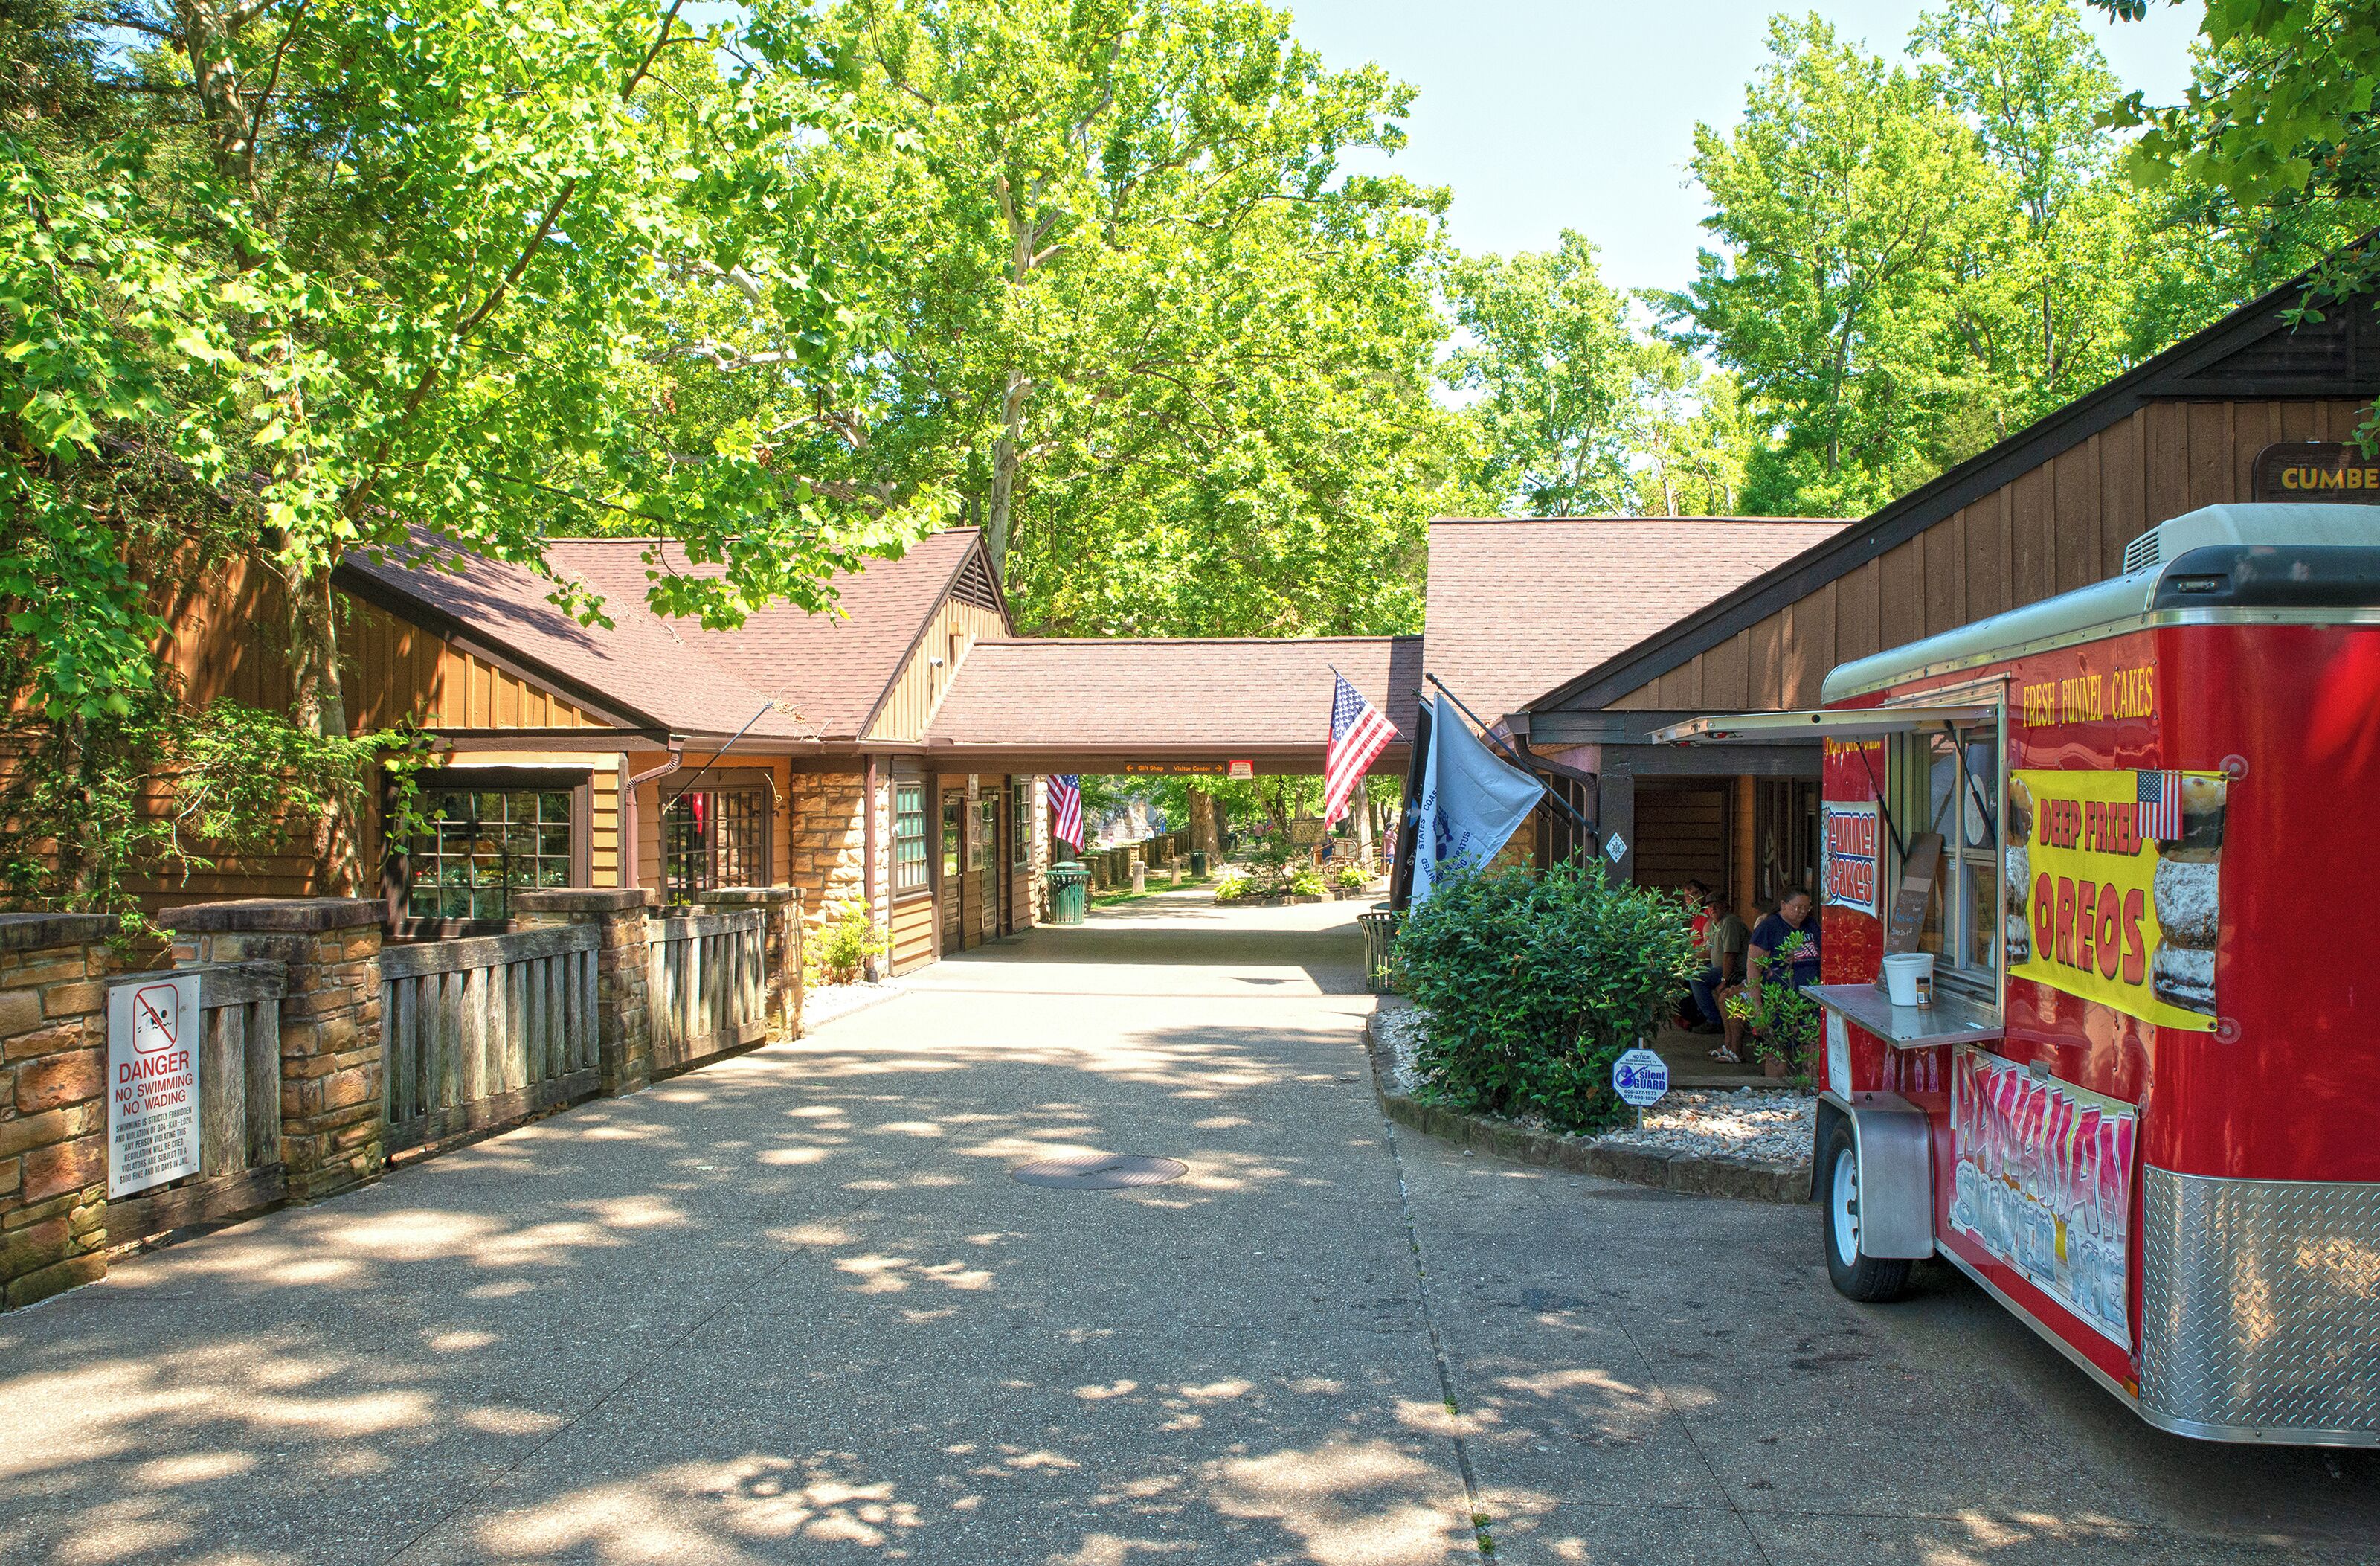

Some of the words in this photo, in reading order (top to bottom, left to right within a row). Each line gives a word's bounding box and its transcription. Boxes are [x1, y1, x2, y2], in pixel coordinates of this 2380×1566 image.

[2281, 467, 2379, 490] CUMBE
[2023, 681, 2056, 728] FRESH
[2062, 674, 2104, 724] FUNNEL
[2112, 665, 2153, 719] CAKES
[1424, 788, 1437, 811] COAS
[2039, 798, 2082, 850] DEEP
[1421, 858, 1437, 883] NITED
[2034, 872, 2145, 986] OREOS
[119, 1050, 190, 1084] DANGER
[1639, 1070, 1665, 1081] silent
[115, 1087, 132, 1103] NO
[137, 1072, 193, 1097] SWIMMING
[1633, 1079, 1665, 1091] GUARD
[123, 1100, 140, 1117] NO
[144, 1089, 186, 1111] WADING
[116, 1119, 141, 1133] SWIMMING
[141, 1117, 147, 1126] IS
[148, 1112, 167, 1125] STRICTLY
[169, 1106, 192, 1119] FORBIDDEN
[115, 1134, 125, 1143] AND
[126, 1127, 149, 1140] VIOLATION
[150, 1125, 156, 1135] OF
[135, 1136, 153, 1148] PERSON
[154, 1130, 176, 1143] VIOLATING
[177, 1127, 187, 1136] THIS
[1957, 1050, 2132, 1242] HAWAIIAN
[121, 1158, 147, 1172] VIOLATORS
[147, 1155, 156, 1165] ARE
[158, 1149, 176, 1162] SUBJECT
[177, 1147, 183, 1156] TO
[184, 1146, 187, 1155] A
[124, 1147, 152, 1162] REGULATION
[152, 1143, 163, 1154] WILL
[164, 1141, 170, 1150] BE
[119, 1173, 131, 1184] $100
[132, 1169, 143, 1180] FINE
[144, 1167, 154, 1176] AND
[155, 1165, 160, 1174] 10
[161, 1161, 172, 1172] DAYS
[173, 1159, 178, 1168] IN
